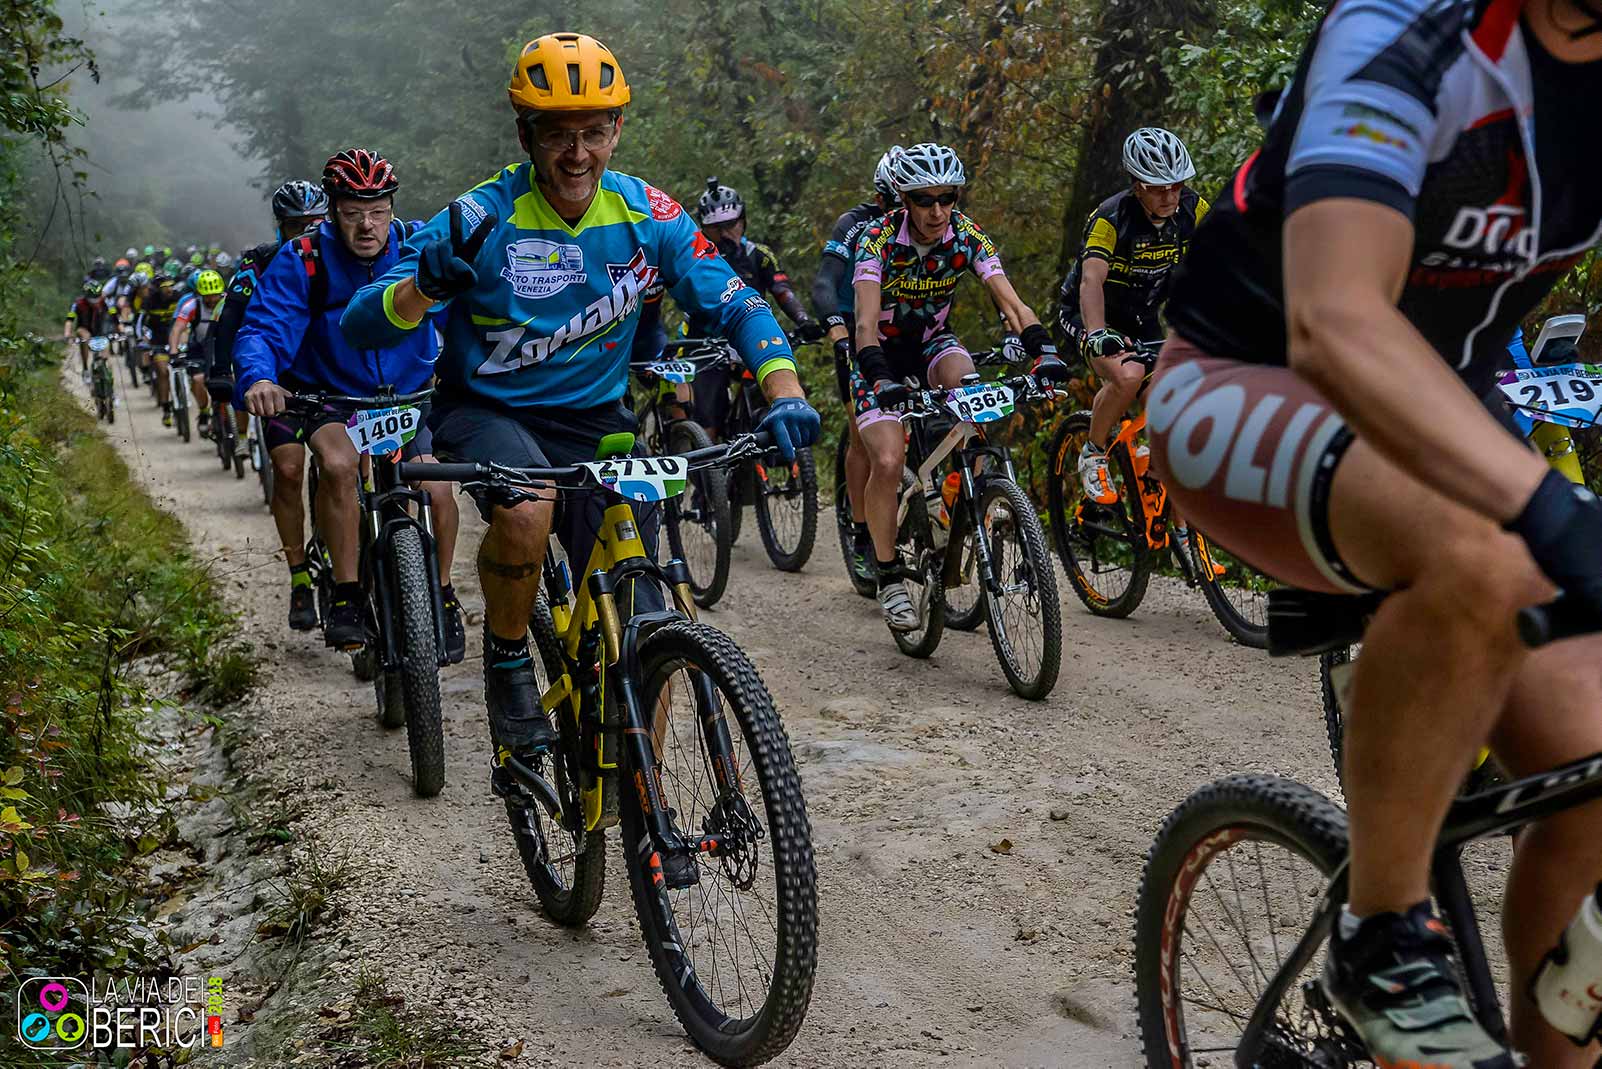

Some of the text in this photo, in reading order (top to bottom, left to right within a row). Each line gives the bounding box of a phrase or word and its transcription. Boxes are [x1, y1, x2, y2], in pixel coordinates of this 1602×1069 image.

[517, 285, 551, 293] VENEZIA
[532, 274, 586, 285] TRASPORTI
[958, 391, 1010, 418] 0364
[359, 412, 413, 447] 1406
